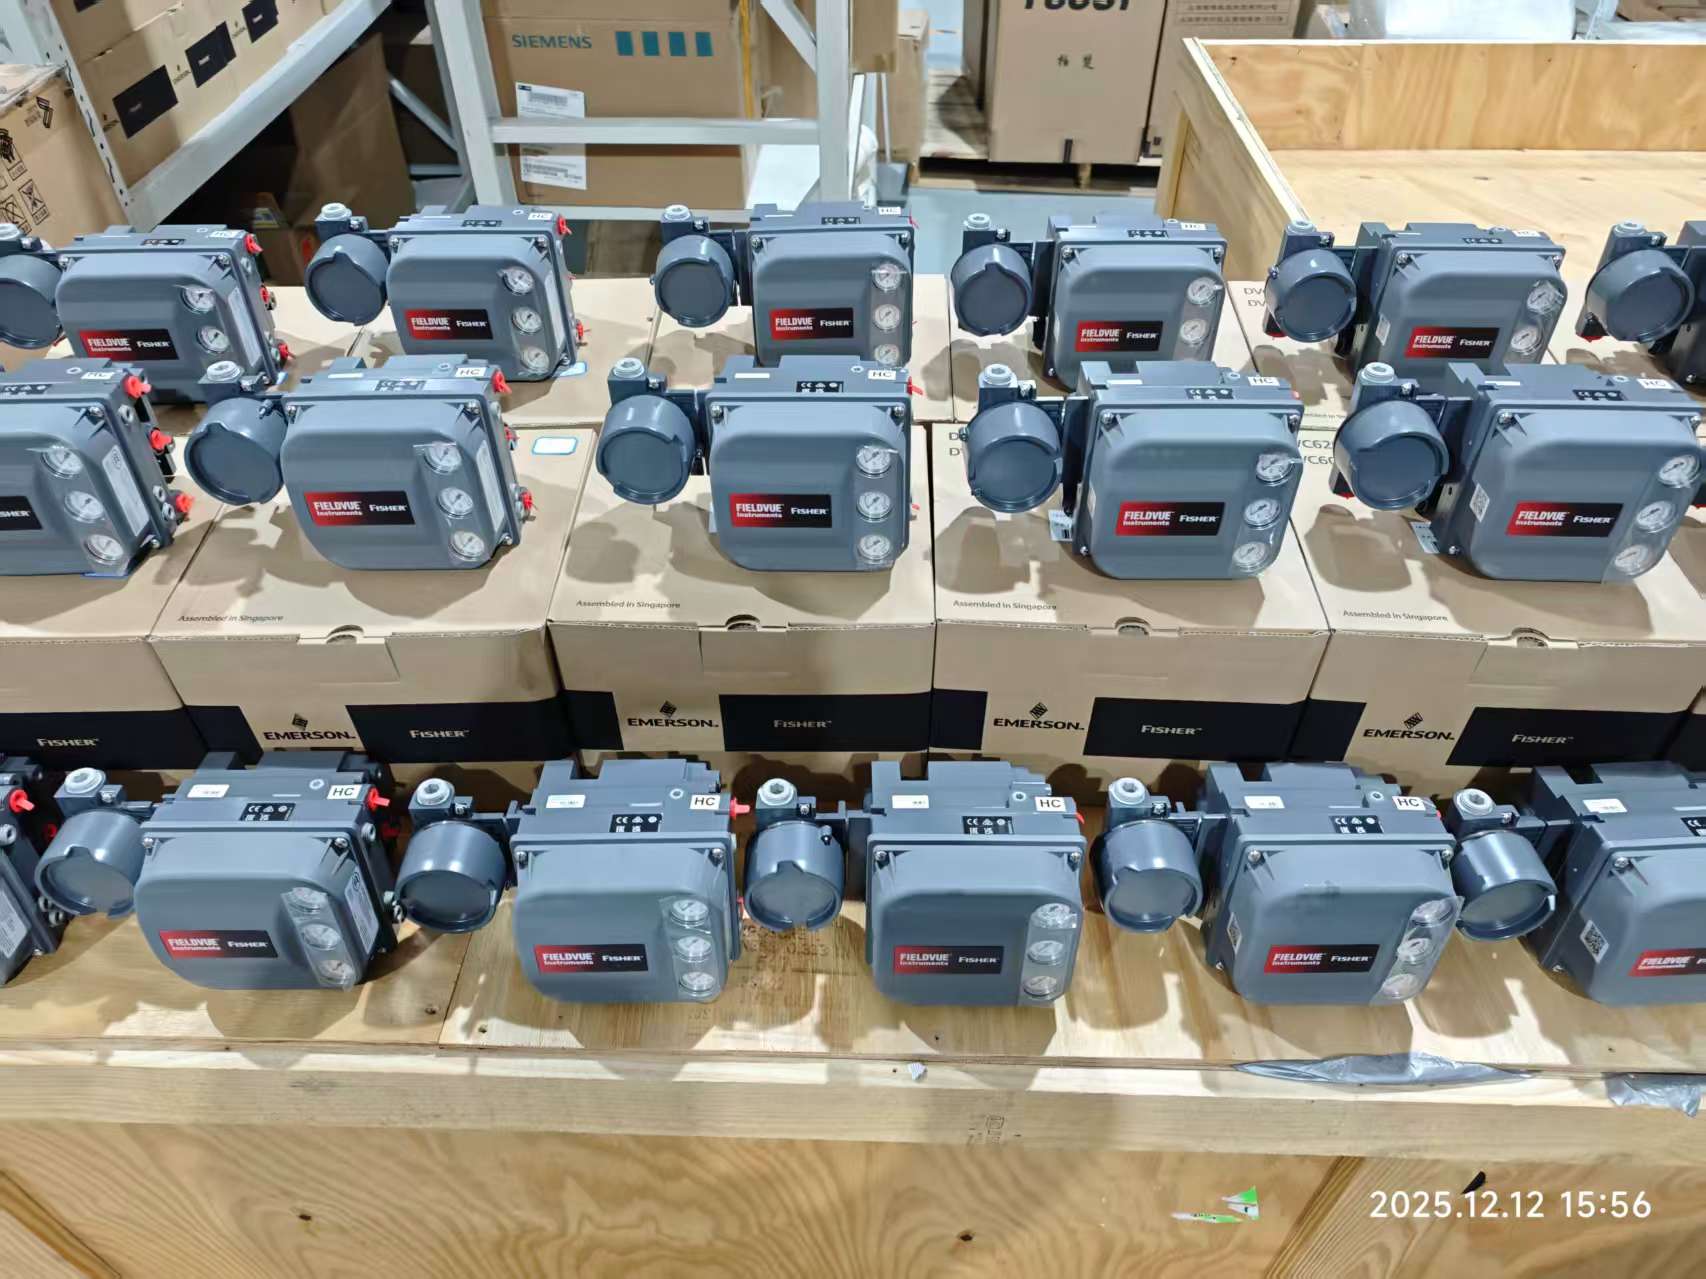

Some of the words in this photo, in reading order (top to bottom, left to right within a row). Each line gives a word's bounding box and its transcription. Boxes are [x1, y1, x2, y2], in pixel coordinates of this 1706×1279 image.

[512, 34, 593, 49] SIEMENS
[411, 317, 450, 326] FIELDVUE
[456, 320, 487, 328] FISHER
[776, 317, 814, 326] FIELDVUE
[820, 319, 851, 327] FISHER
[1081, 328, 1120, 337] FIELDVUE
[1126, 331, 1157, 339] FISHER
[88, 338, 130, 347] FIELDVUE
[137, 340, 170, 348] FISHER
[1414, 335, 1454, 344] FIELDVUE
[1459, 339, 1492, 347] FISHER
[459, 368, 481, 376] HC
[1253, 377, 1274, 385] HC
[314, 501, 361, 510] FIELDVUE
[369, 504, 406, 512] FISHER
[736, 503, 783, 512] FIELDVUE
[1124, 511, 1173, 520] FIELDVUE
[1179, 514, 1218, 522] FISHER
[1518, 511, 1567, 520] FIELDVUE
[1573, 515, 1612, 524] FISHER
[576, 600, 625, 608] Assembled
[636, 601, 681, 610] Singapore
[952, 600, 1001, 608] Assembled
[1013, 602, 1057, 611] Singapore
[178, 614, 228, 622] Assembled
[239, 614, 284, 623] Singapore
[1342, 610, 1391, 618] Assembled
[1402, 613, 1448, 622] Singapore
[773, 719, 831, 729] FISHER
[1141, 724, 1202, 735] FISHER
[408, 728, 469, 739] FISHER
[36, 737, 99, 748] FISHER
[1511, 734, 1574, 745] FISHER
[332, 786, 355, 797] HC
[694, 796, 716, 806] HC
[1039, 798, 1062, 809] HC
[1397, 797, 1420, 808] HC
[543, 952, 594, 961] FIELDVUE
[899, 953, 950, 962] FIELDVUE
[1273, 953, 1324, 961] FIELDVUE
[1331, 955, 1370, 963] FISHER
